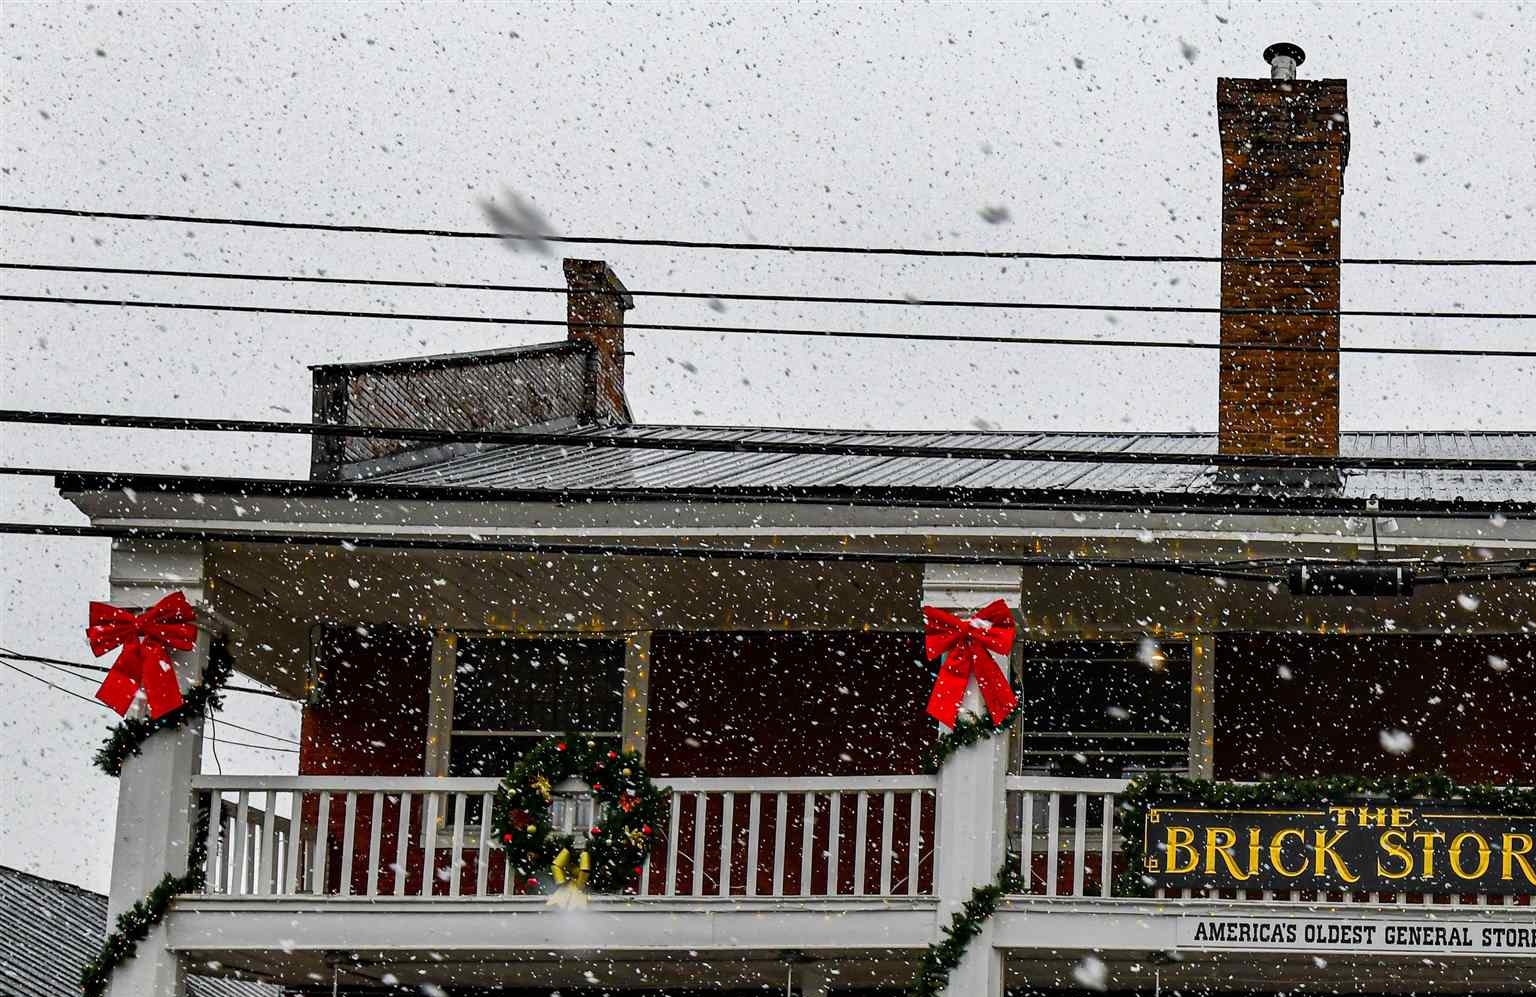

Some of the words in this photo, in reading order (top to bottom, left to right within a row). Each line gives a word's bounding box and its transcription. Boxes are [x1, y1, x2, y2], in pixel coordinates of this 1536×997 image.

[1329, 806, 1417, 827] THE
[1165, 826, 1361, 883] BRICK
[1194, 922, 1297, 943] AMERICA'S
[1304, 924, 1376, 945] OLDEST
[1384, 926, 1473, 947] GENERAL
